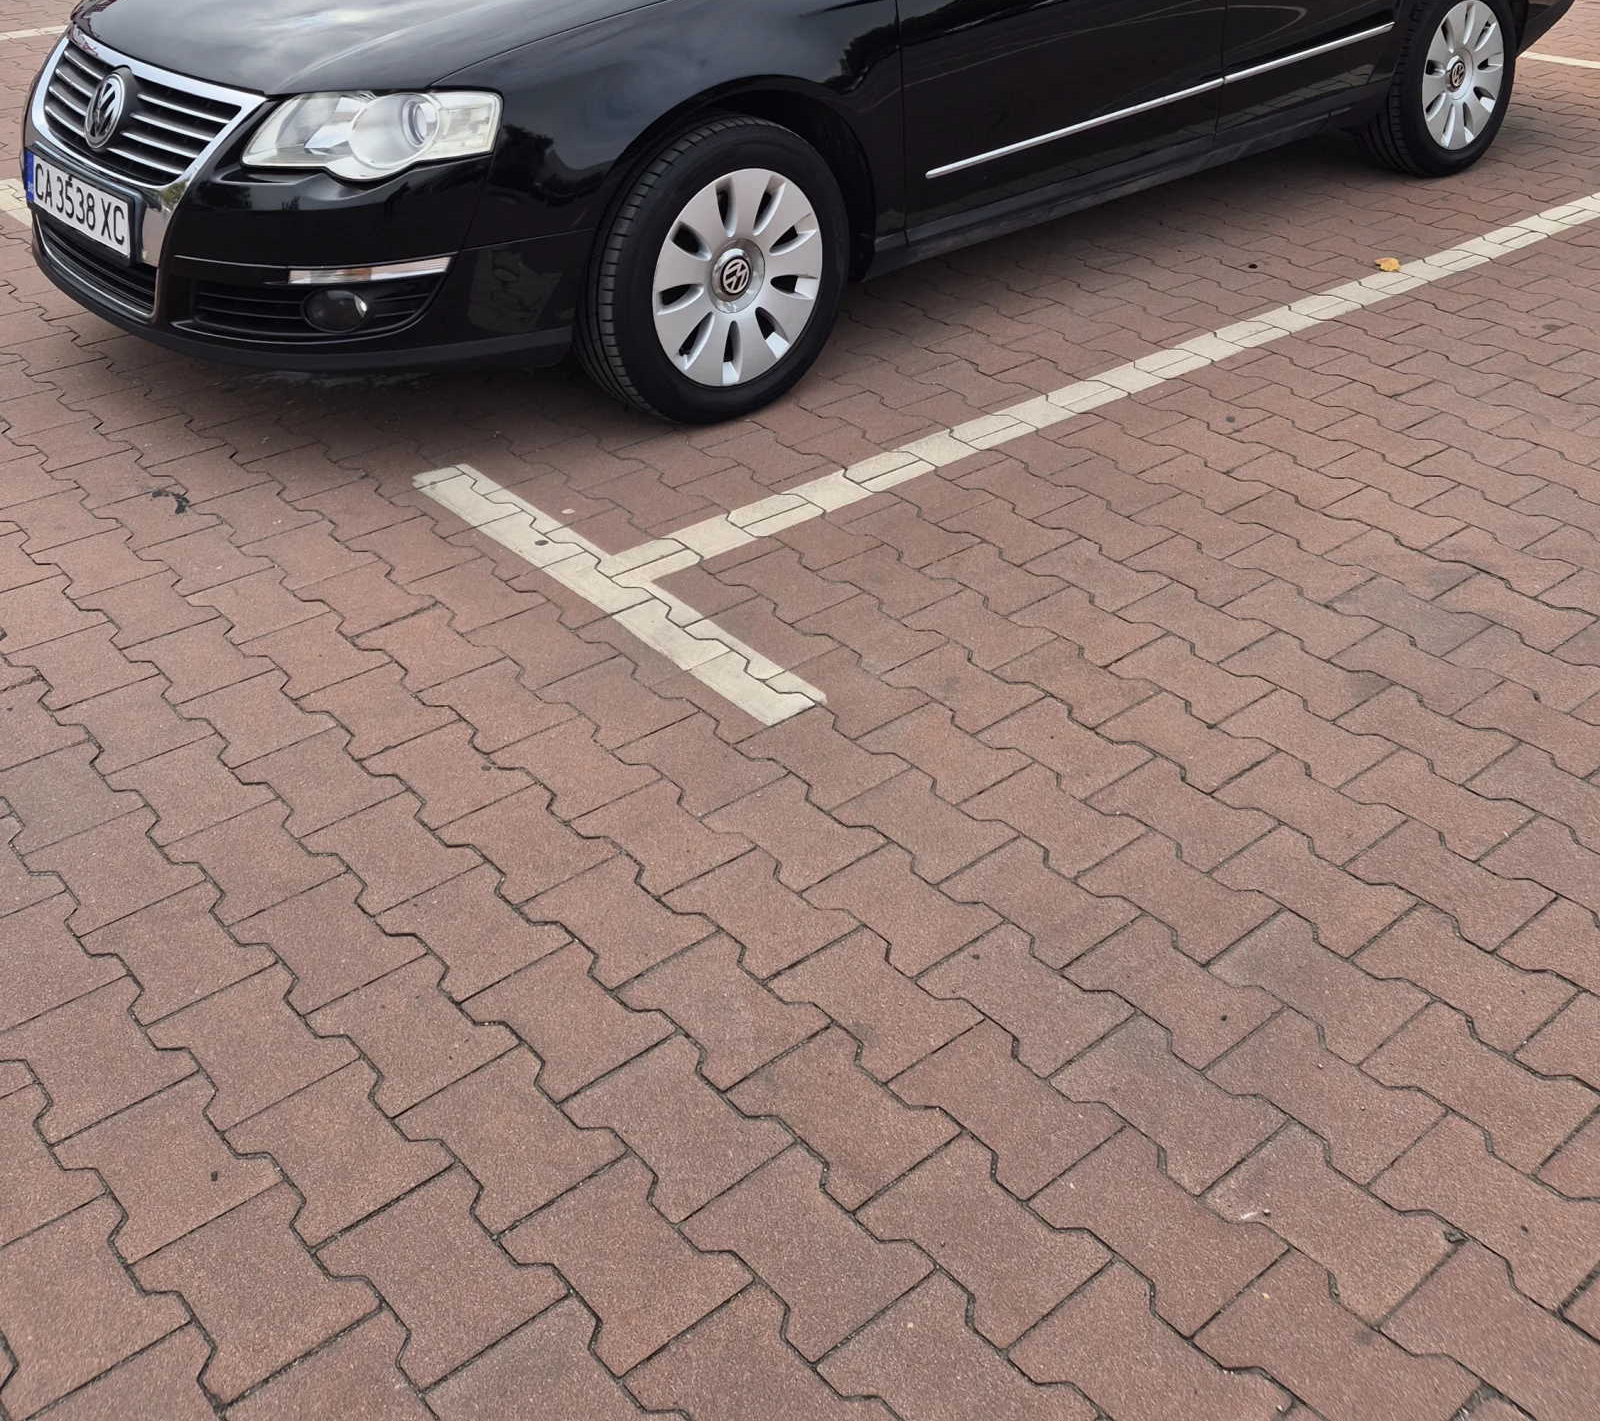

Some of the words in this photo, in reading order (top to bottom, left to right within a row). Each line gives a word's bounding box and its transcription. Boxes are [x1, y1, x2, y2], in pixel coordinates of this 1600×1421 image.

[35, 163, 53, 208] CA
[56, 174, 96, 231] 3538
[101, 197, 125, 246] XC
